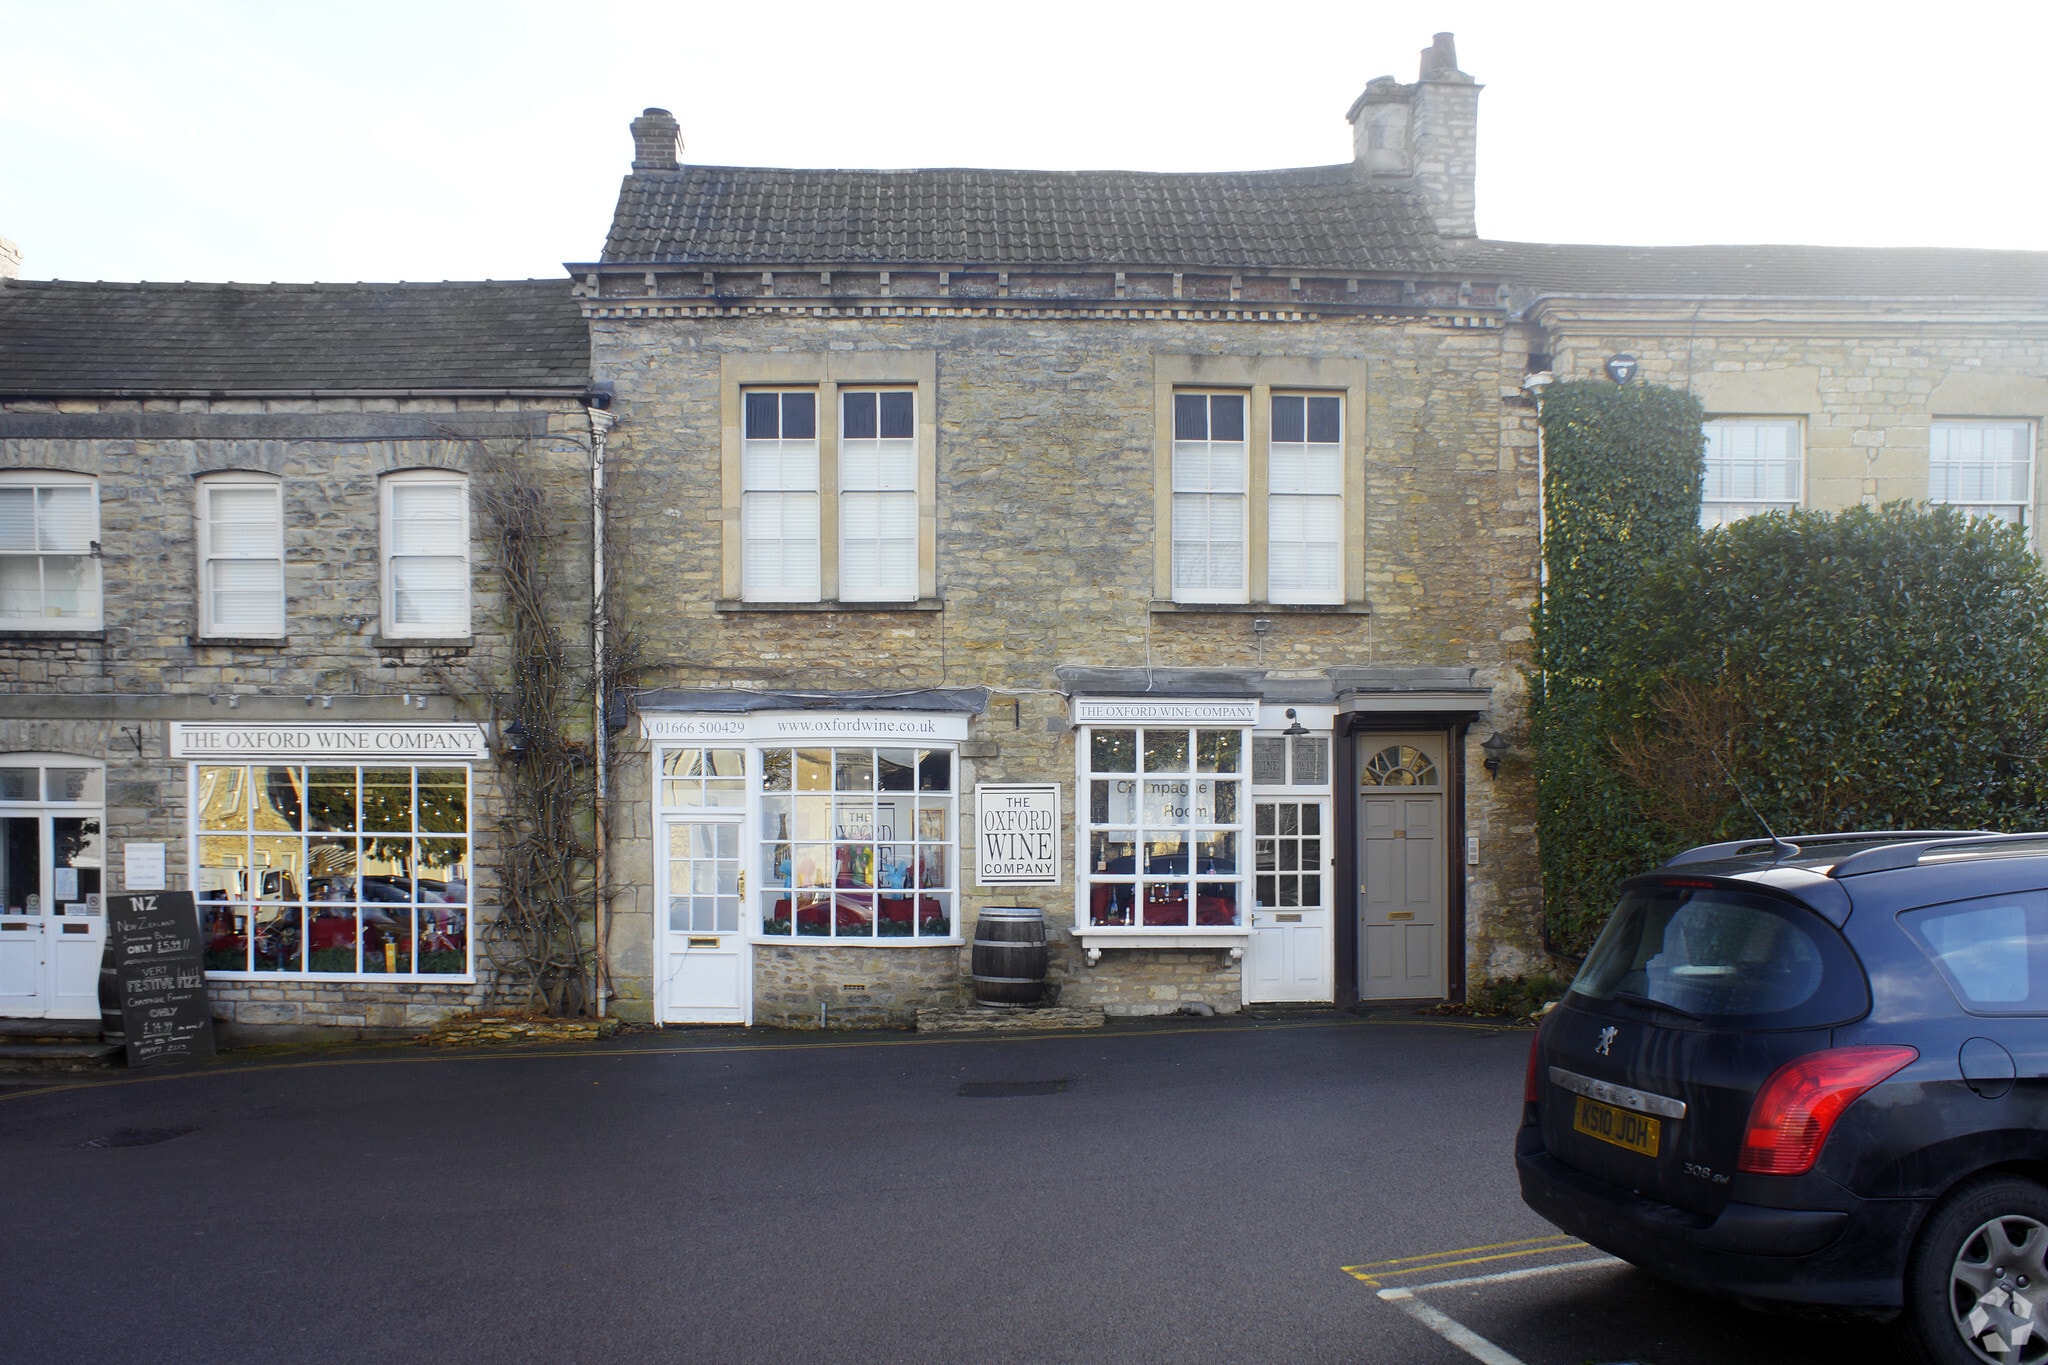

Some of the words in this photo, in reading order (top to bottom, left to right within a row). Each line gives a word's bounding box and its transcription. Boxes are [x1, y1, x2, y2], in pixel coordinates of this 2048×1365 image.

[1080, 706, 1104, 717] THE
[1106, 706, 1157, 717] OXFORD
[1160, 706, 1192, 717] WINE
[1194, 706, 1254, 717] COMPANY
[656, 721, 695, 734] 01666
[698, 721, 745, 734] 500429
[777, 717, 936, 733] www.oxfordwine.co.uk
[181, 732, 222, 749] THE
[226, 732, 310, 749] OXFORD
[316, 732, 370, 750] WINE
[375, 732, 478, 750] COMPANY
[1006, 797, 1030, 808] THE
[848, 812, 873, 823] THE
[984, 810, 1052, 831] OXFORD
[984, 833, 1053, 861] WINE
[984, 863, 1053, 874] COMPANY
[127, 944, 153, 954] ONLY
[142, 966, 168, 977] VERY
[126, 977, 175, 992] FESTIVE
[1581, 1102, 1613, 1136] KS10
[1616, 1114, 1649, 1148] JOH
[1684, 1162, 1711, 1179] 308
